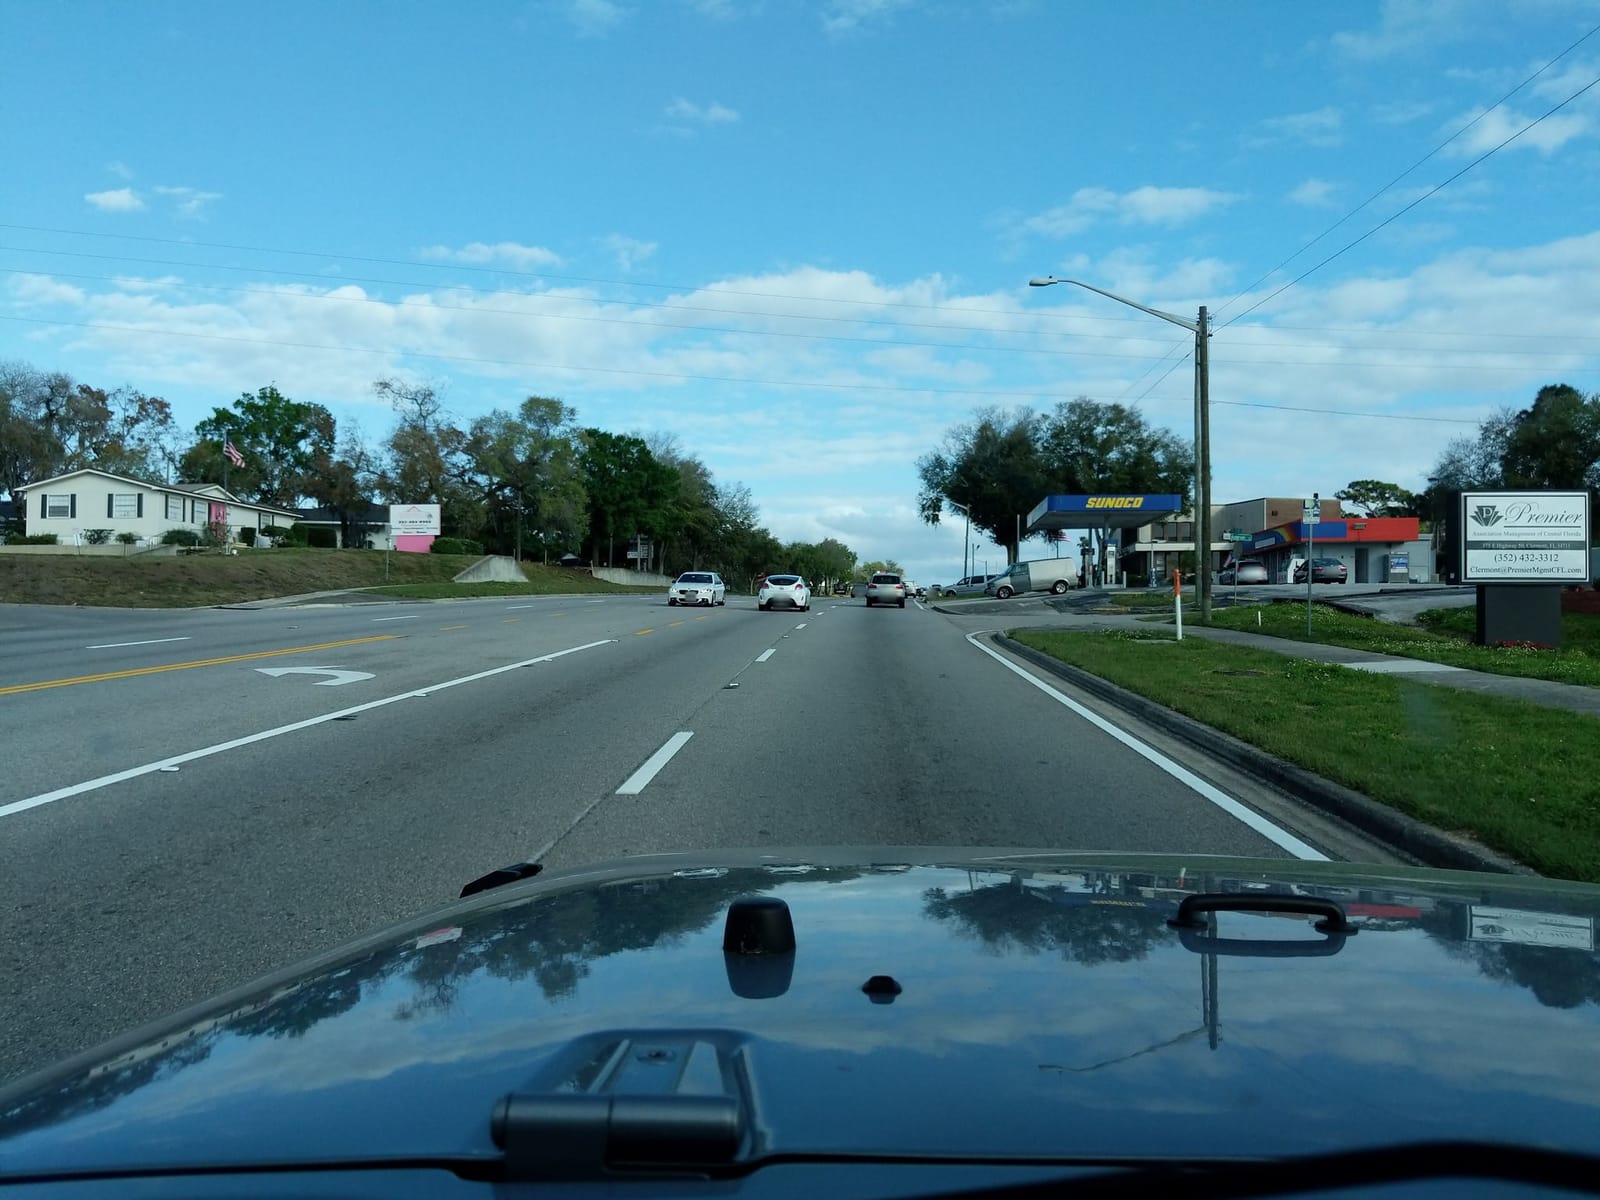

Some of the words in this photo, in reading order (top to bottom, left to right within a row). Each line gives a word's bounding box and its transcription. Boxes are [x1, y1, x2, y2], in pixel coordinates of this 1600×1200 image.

[1085, 497, 1144, 509] SUNOCO
[1504, 501, 1583, 524] Premier
[1494, 554, 1517, 563] (352)
[1519, 554, 1559, 562] 432-3312
